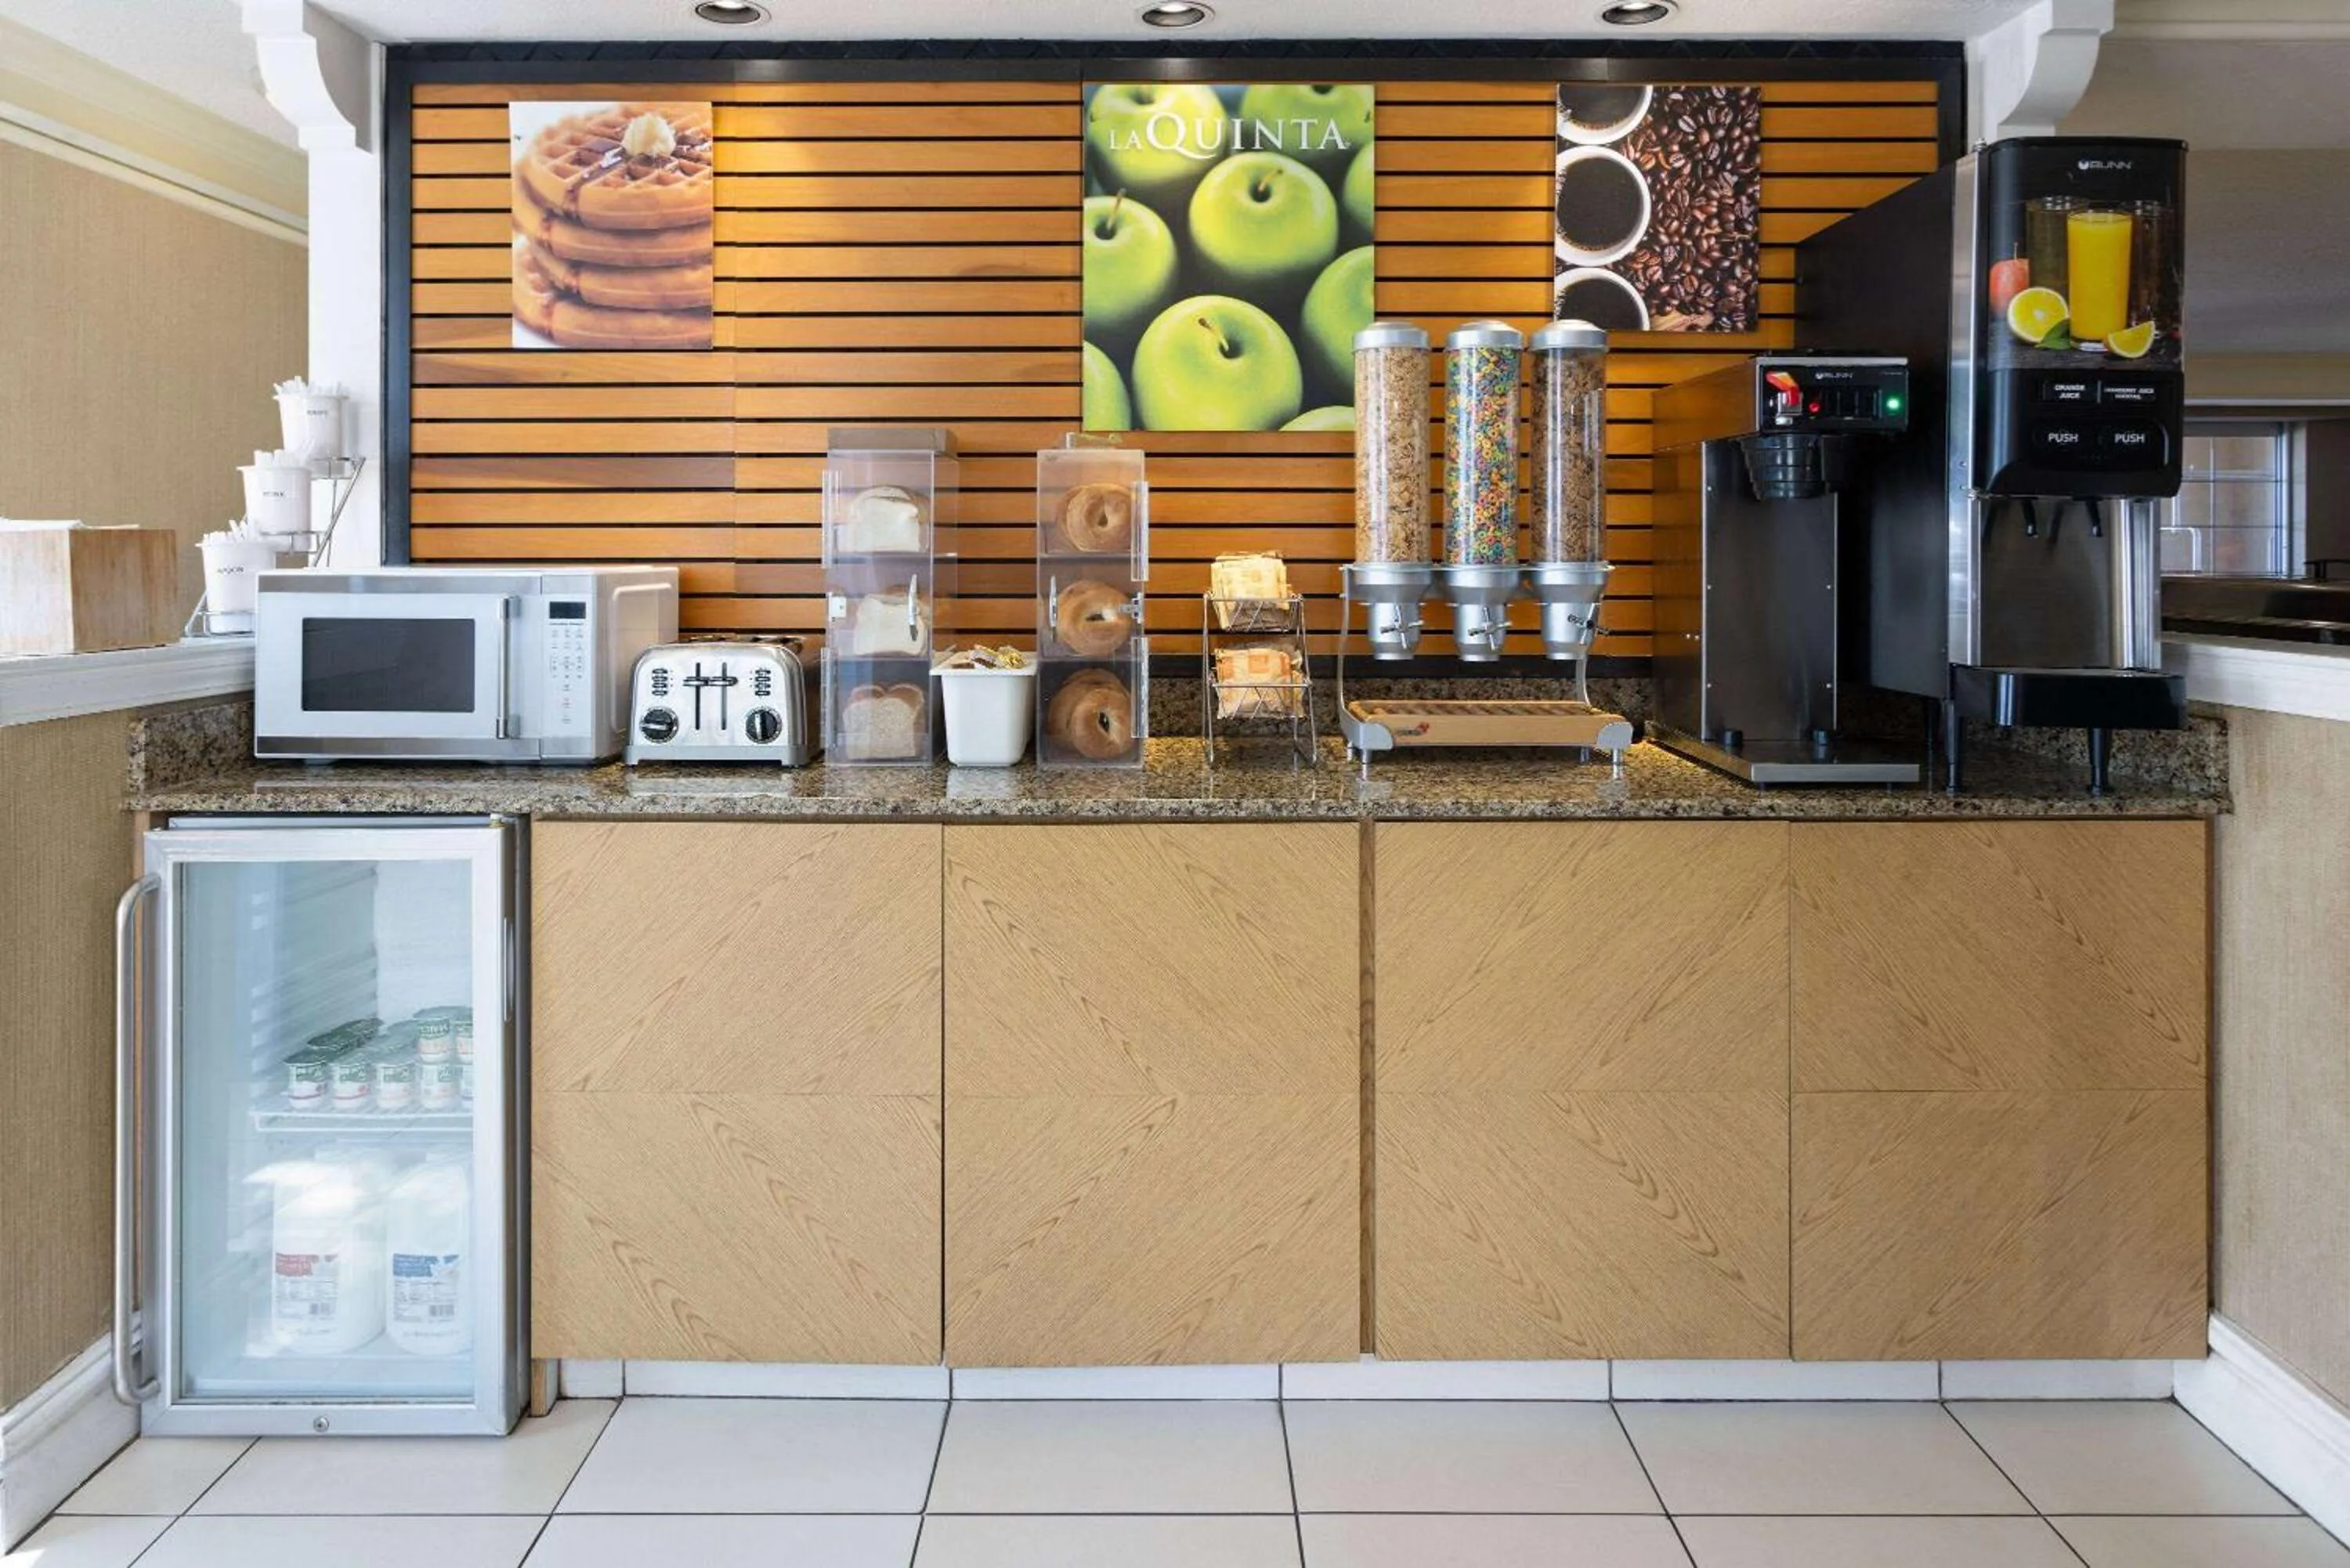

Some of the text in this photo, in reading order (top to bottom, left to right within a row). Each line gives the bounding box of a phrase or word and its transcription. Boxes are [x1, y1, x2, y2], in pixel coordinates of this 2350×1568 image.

[1109, 111, 1347, 159] LA QUINTA
[2048, 432, 2079, 443] PUSH
[2114, 433, 2146, 443] PUSH
